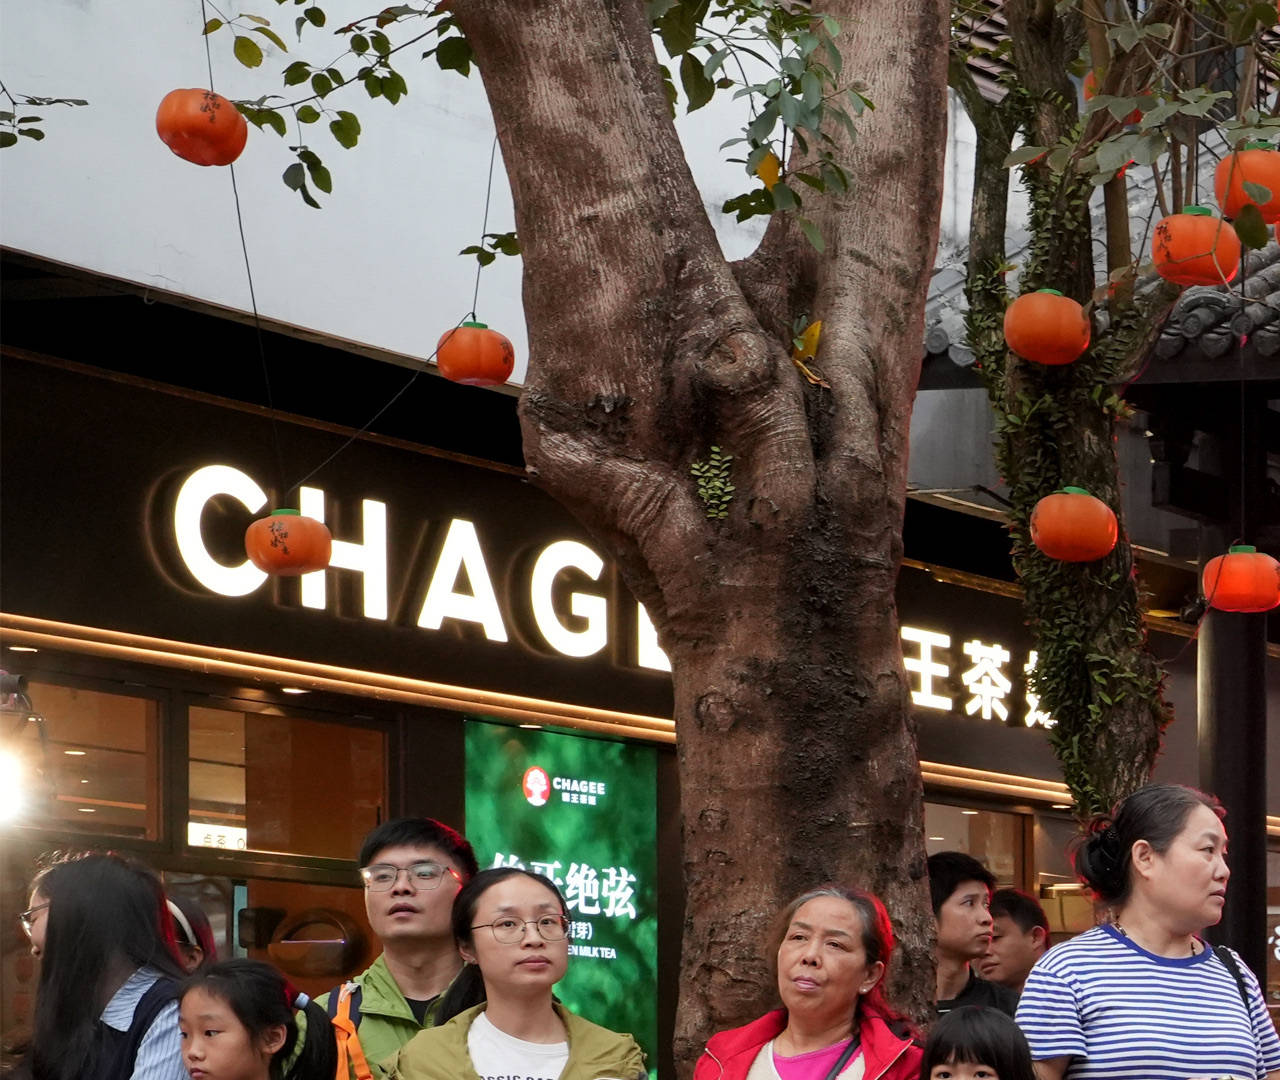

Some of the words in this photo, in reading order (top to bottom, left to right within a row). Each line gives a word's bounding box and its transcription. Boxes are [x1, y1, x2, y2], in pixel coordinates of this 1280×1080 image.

[552, 777, 606, 795] CHAGEE
[491, 852, 638, 920] 牙绝弦
[600, 948, 617, 959] TEA
